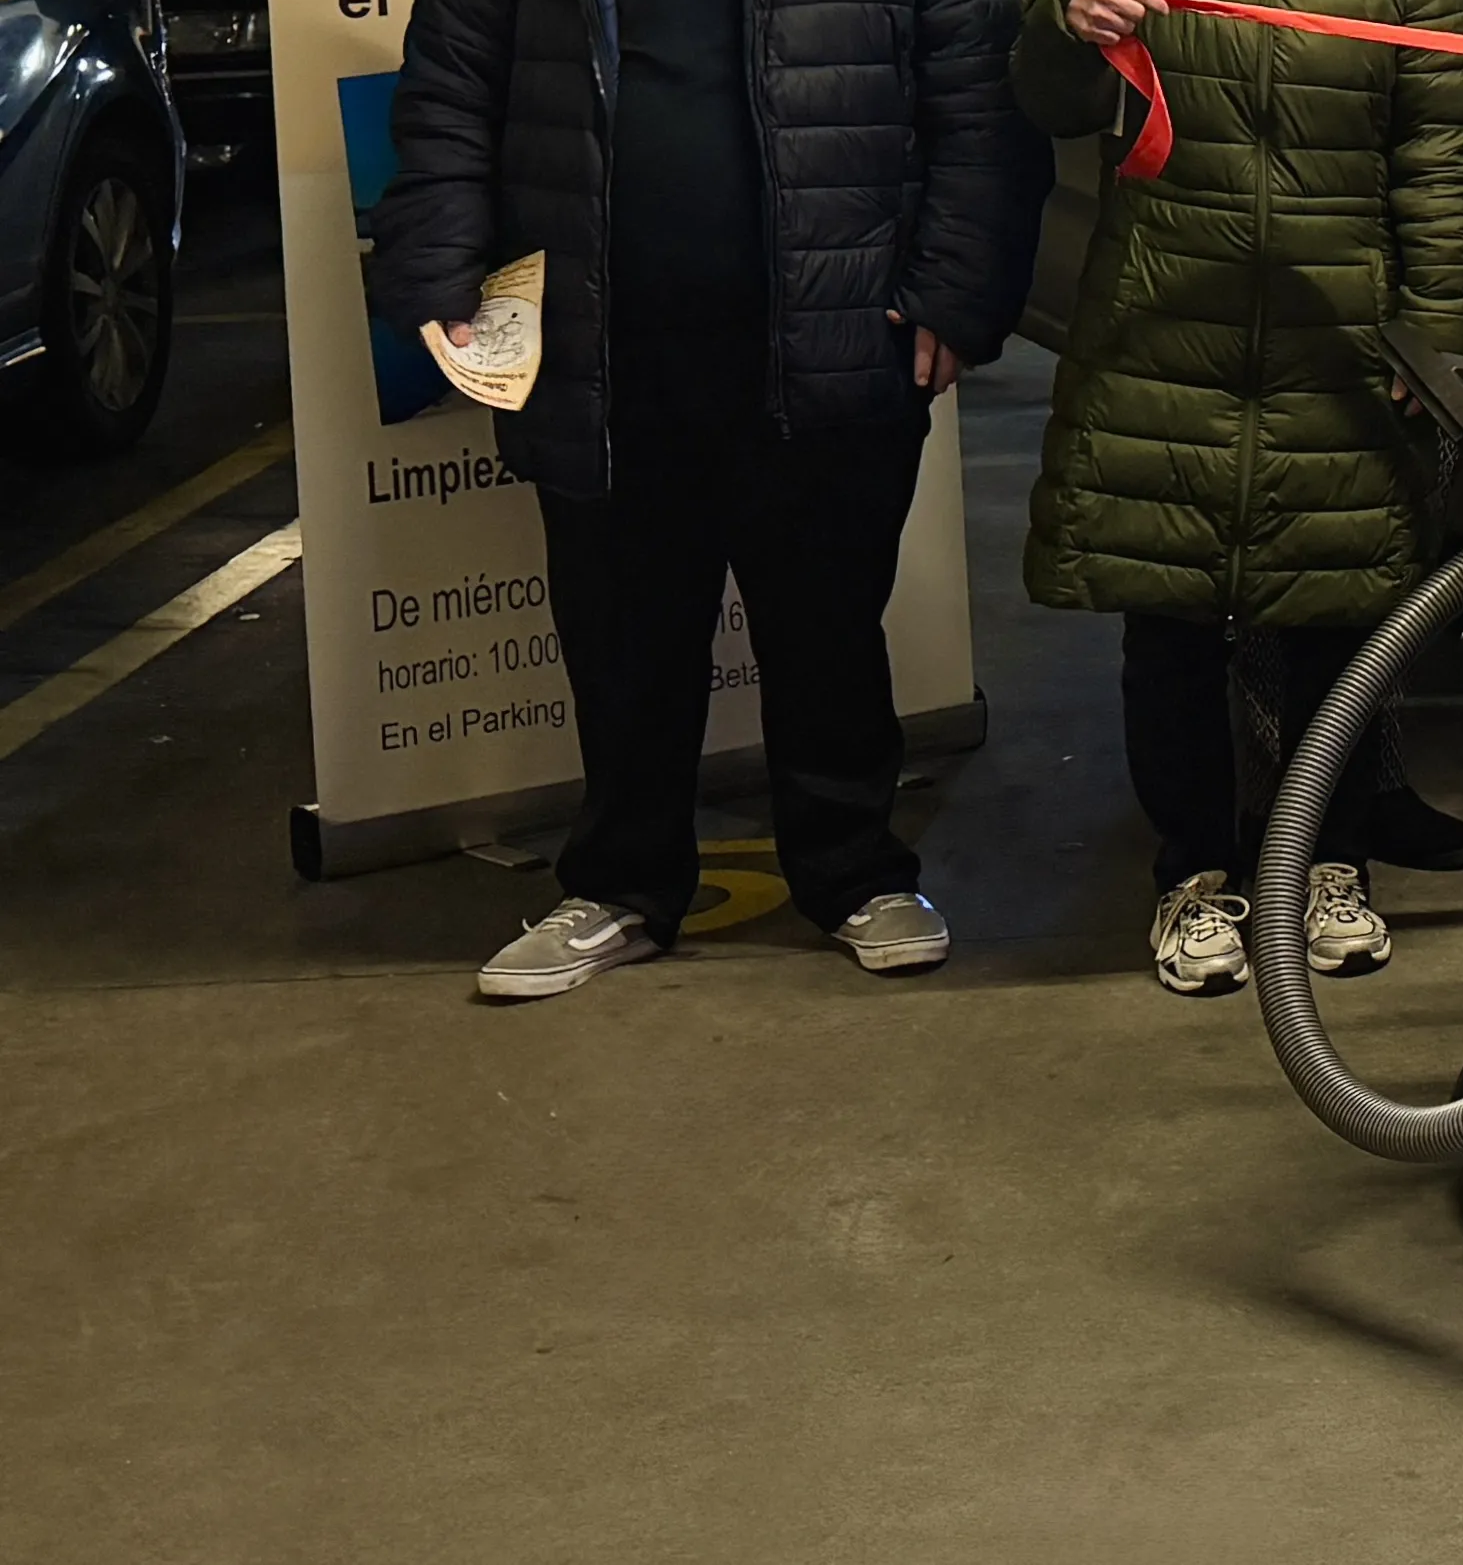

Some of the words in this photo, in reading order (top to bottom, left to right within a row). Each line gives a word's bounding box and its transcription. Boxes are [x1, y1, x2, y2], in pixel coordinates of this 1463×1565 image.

[371, 588, 421, 632] De
[433, 573, 546, 623] miérco
[379, 649, 478, 692] horario:
[489, 632, 560, 674] 10.00
[381, 722, 418, 751] En
[429, 713, 451, 743] el
[462, 699, 566, 736] Parking
